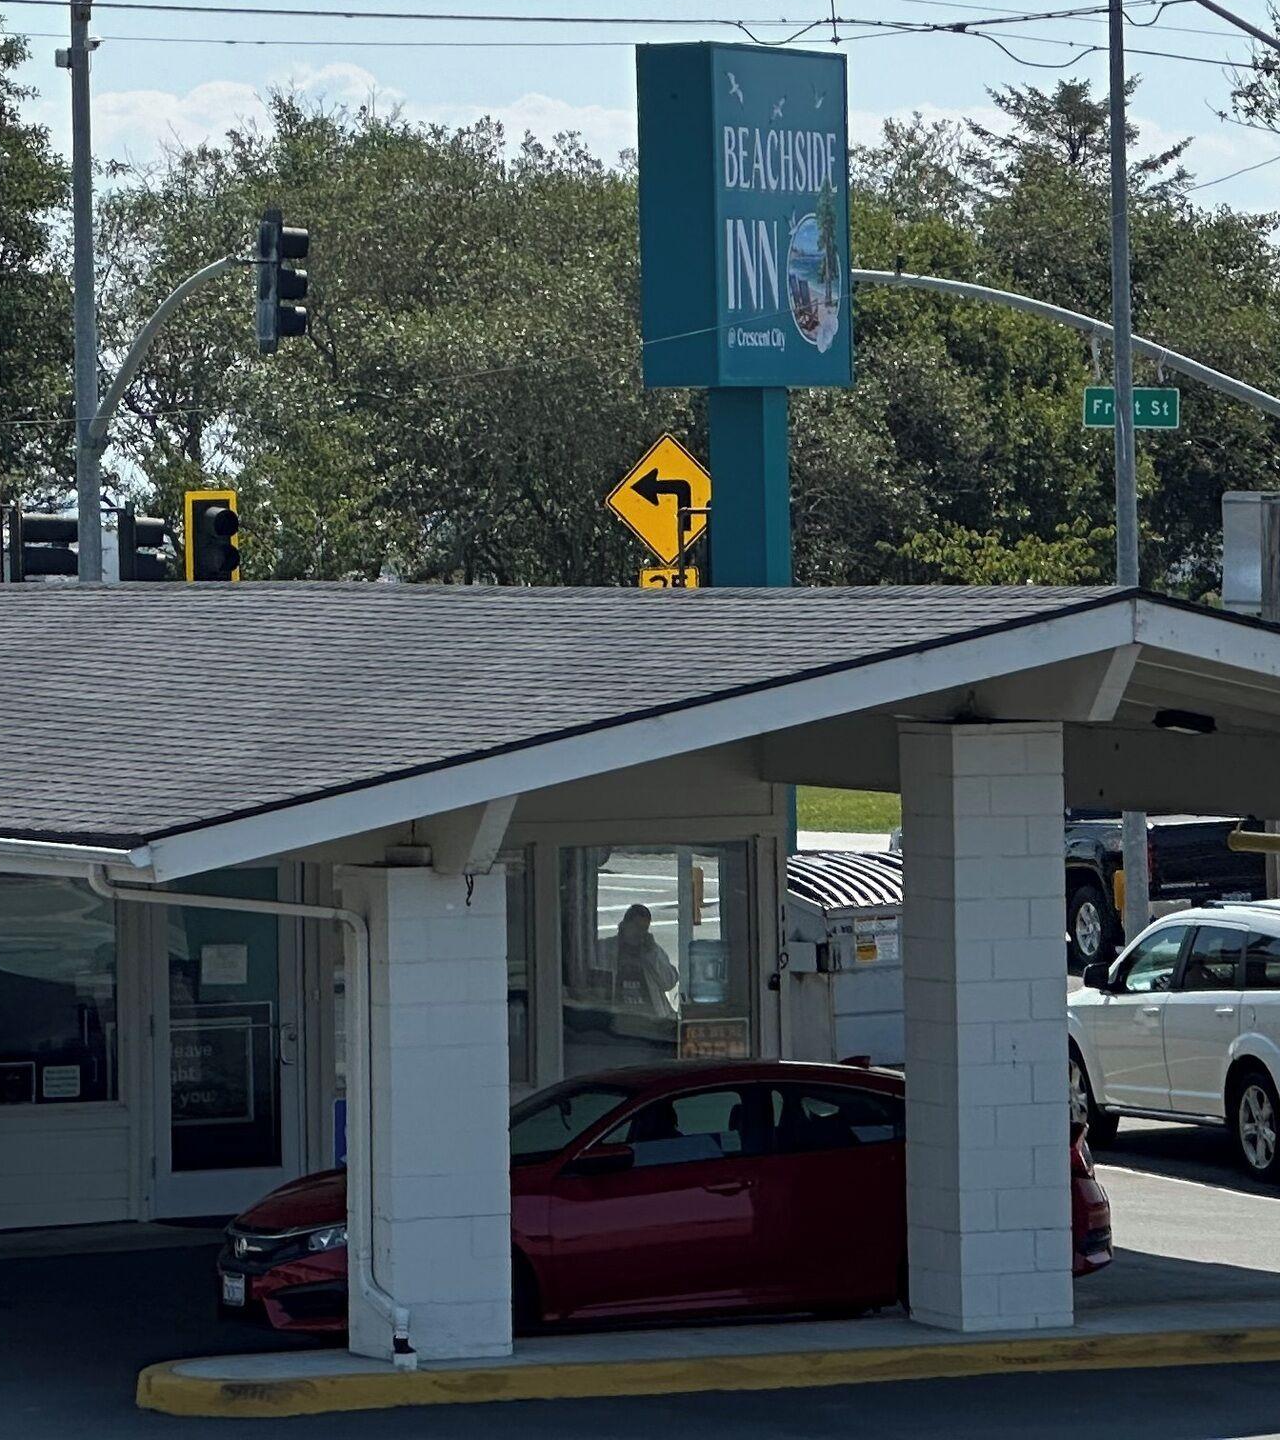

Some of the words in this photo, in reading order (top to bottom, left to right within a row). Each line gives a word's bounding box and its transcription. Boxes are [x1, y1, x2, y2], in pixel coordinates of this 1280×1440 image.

[723, 126, 838, 193] BEACHSIDE
[726, 219, 779, 309] INN
[737, 328, 770, 347] Crescent
[771, 328, 785, 352] City
[1093, 399, 1141, 416] Frt
[1151, 400, 1169, 416] St
